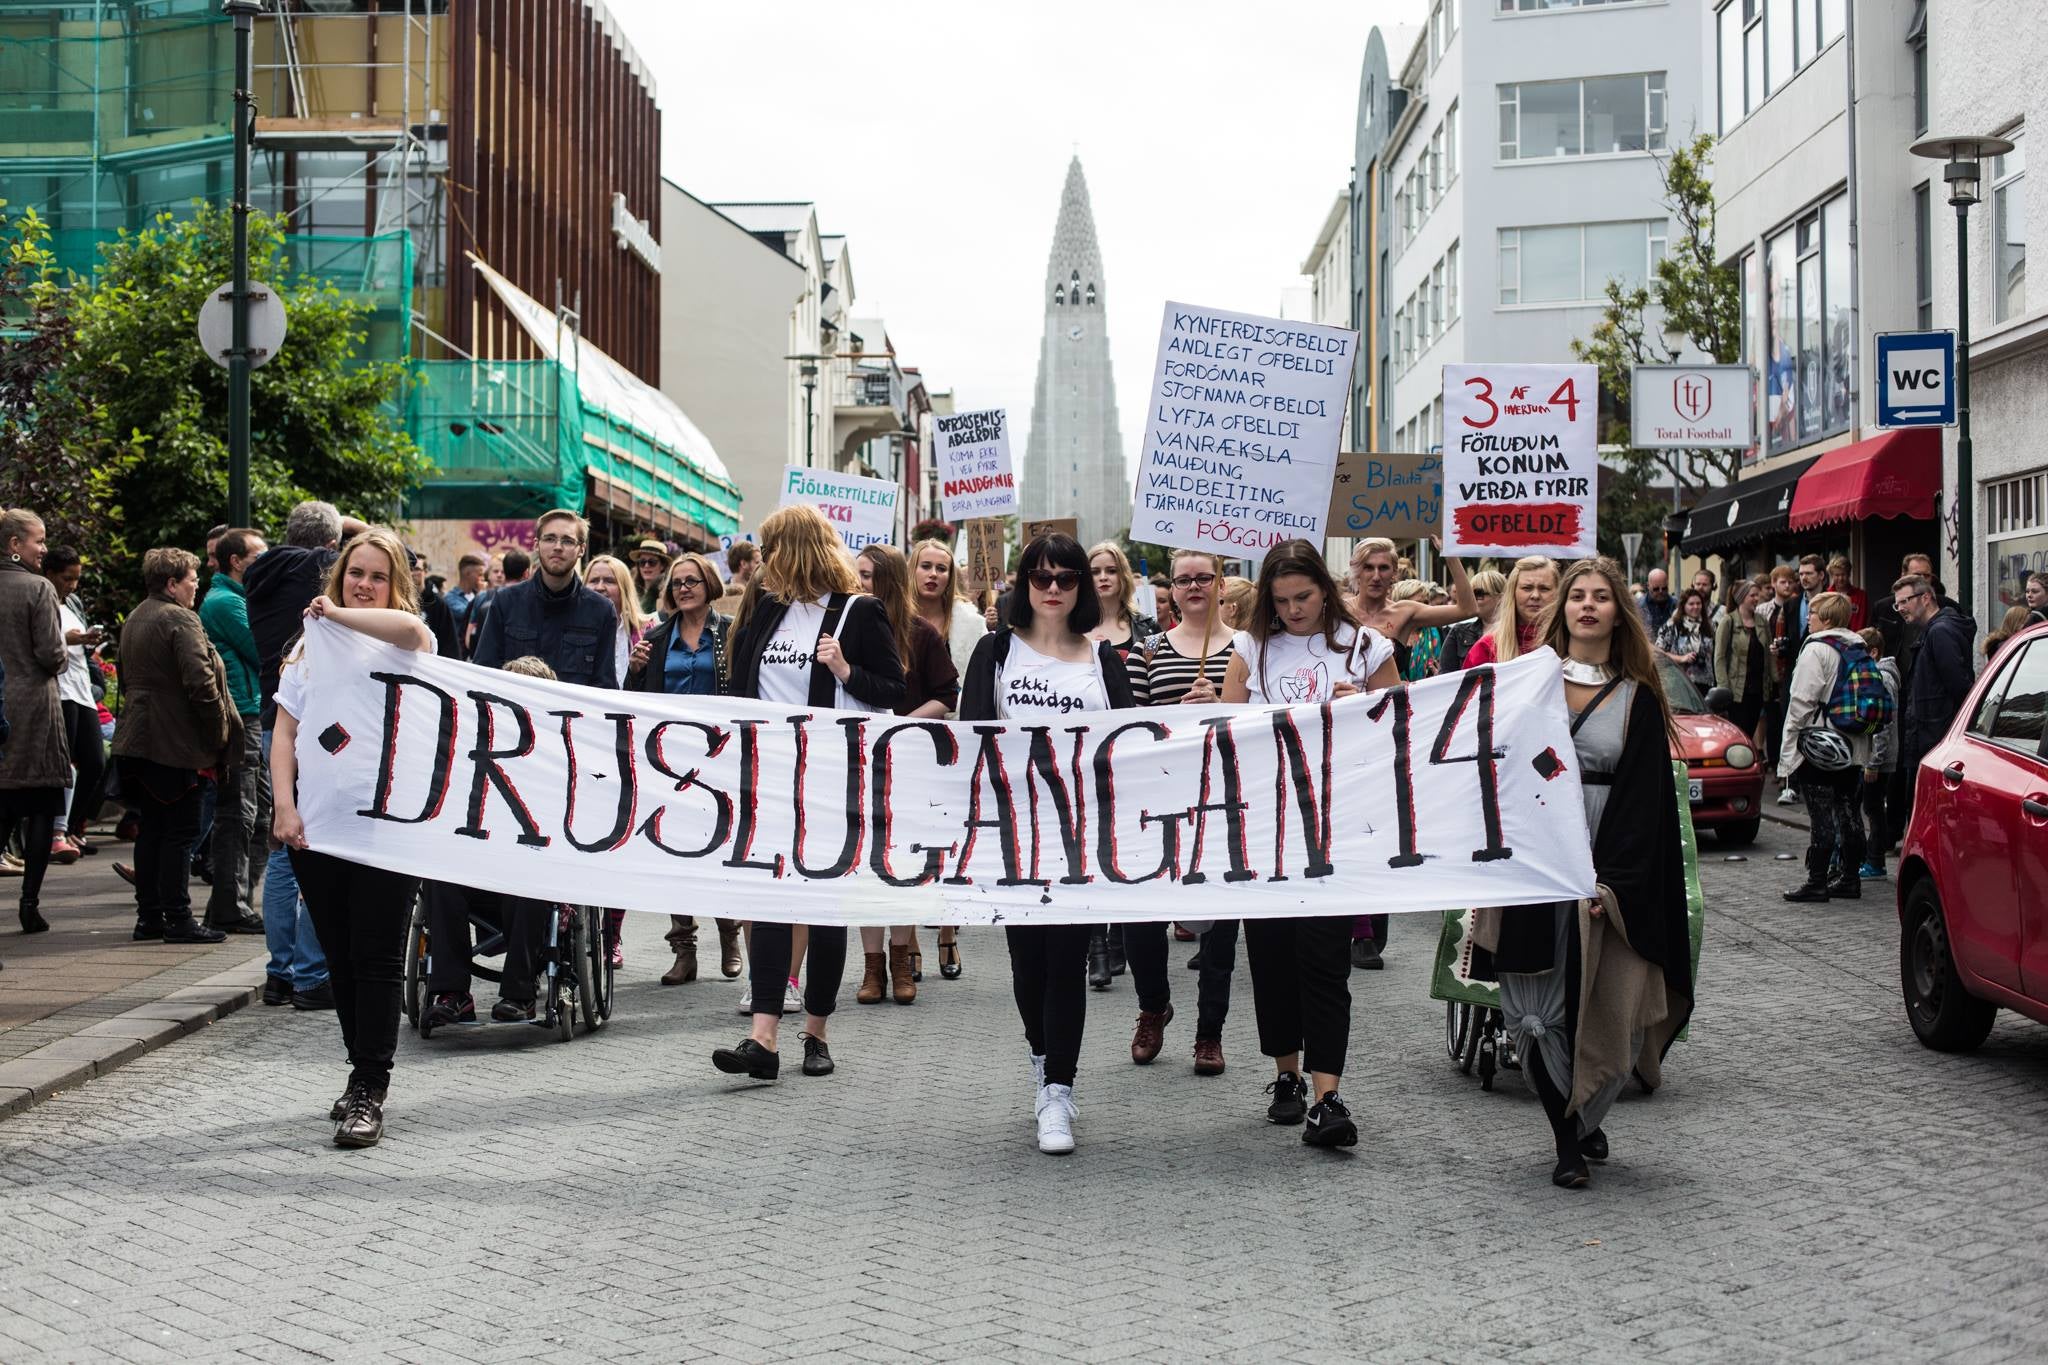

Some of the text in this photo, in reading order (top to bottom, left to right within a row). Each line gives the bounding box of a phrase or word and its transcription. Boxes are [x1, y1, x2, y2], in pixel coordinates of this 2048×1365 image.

[1173, 312, 1348, 356] KYNFERÐISOFBELDI
[1167, 336, 1334, 376] ANDLEGT OFBELDI
[1164, 360, 1266, 389] FORDÓMAR
[1892, 369, 1941, 391] WC
[1160, 380, 1327, 417] STOFNANA OFBELDI
[1462, 376, 1499, 429] 3
[1510, 386, 1531, 400] AF
[1547, 377, 1581, 422] 4
[1158, 404, 1301, 440] LYFJA OFBELDI
[1654, 427, 1732, 439] Total Football
[1156, 430, 1292, 465] VANRÆKSLA
[1152, 449, 1243, 480] NAUÐUNG
[1478, 452, 1570, 476] KONUM
[1148, 472, 1285, 505] VALDBEITING
[1534, 477, 1589, 497] FYRIR
[1155, 520, 1175, 534] OG
[1254, 509, 1317, 532] OFBELDI
[1471, 513, 1567, 535] OFBELDI
[1010, 675, 1049, 693] ekki
[356, 665, 1513, 888] DRUSLUGANGAN 14
